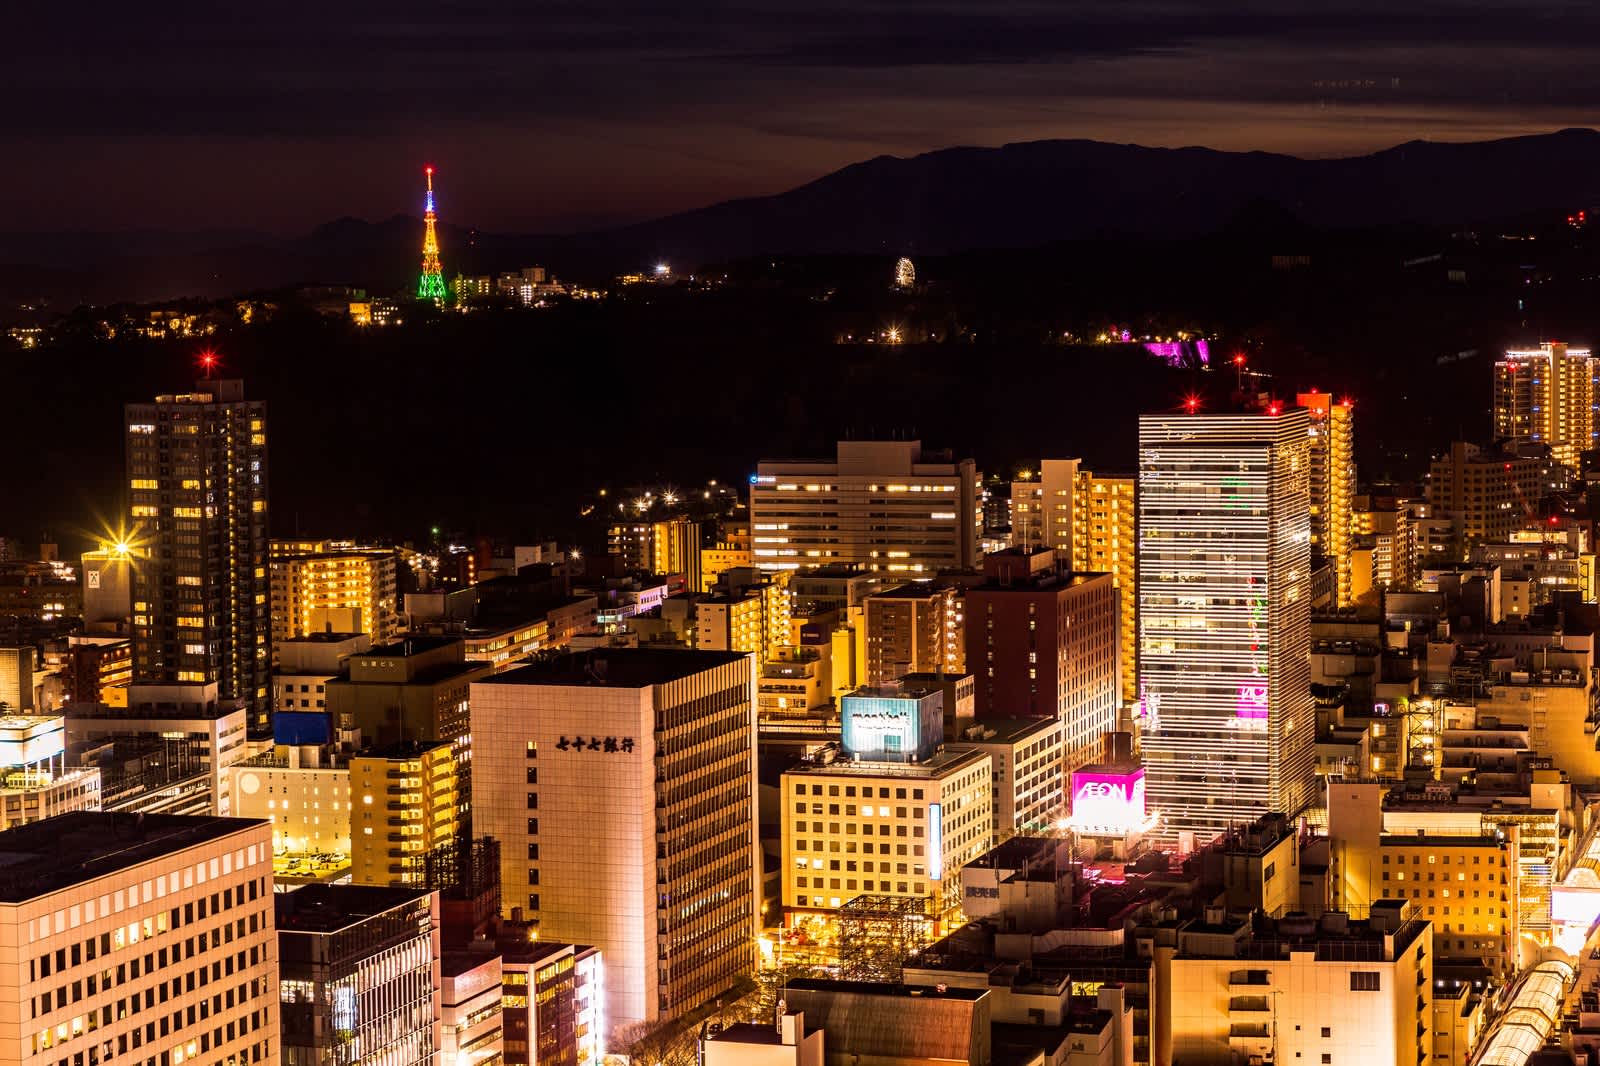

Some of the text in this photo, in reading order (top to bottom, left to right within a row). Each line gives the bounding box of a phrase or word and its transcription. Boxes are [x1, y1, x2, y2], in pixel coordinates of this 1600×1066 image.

[555, 735, 635, 754] 七十七銀行
